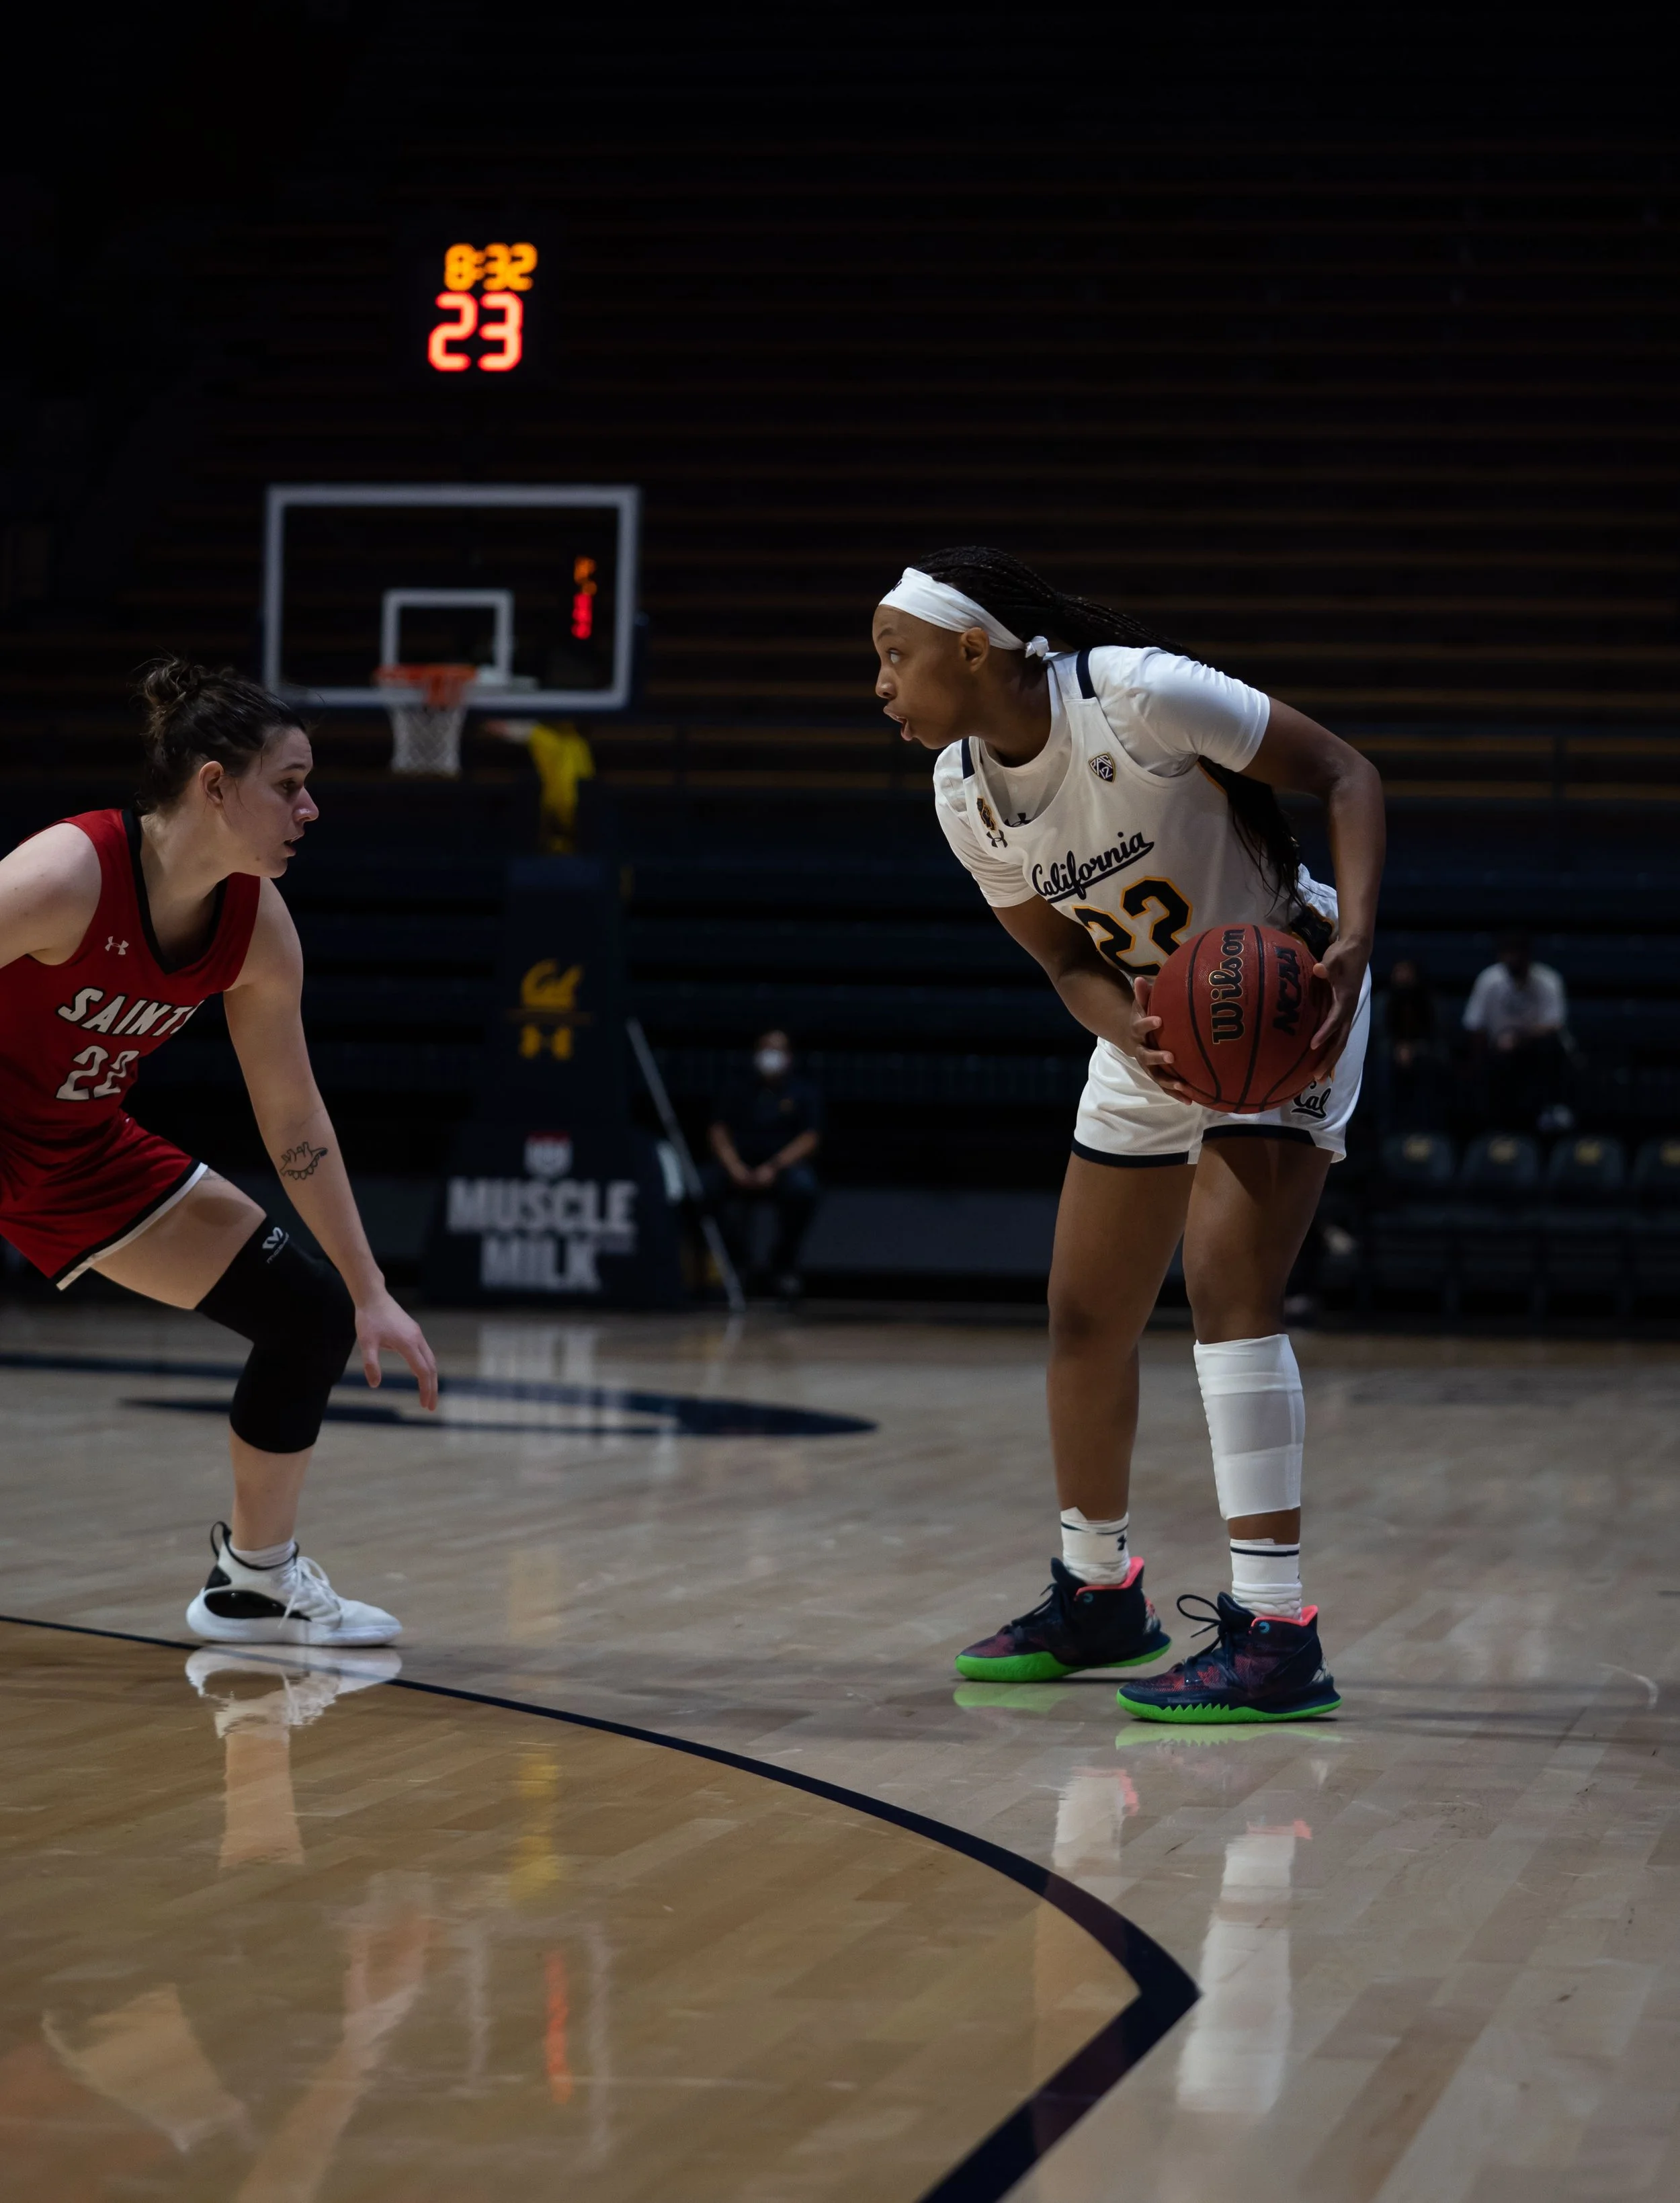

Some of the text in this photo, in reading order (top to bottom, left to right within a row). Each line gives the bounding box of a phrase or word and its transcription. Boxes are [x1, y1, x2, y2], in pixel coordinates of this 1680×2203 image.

[444, 242, 539, 292] 8:32
[427, 291, 524, 372] 23
[1089, 754, 1113, 776] PAC
[1032, 831, 1155, 904] California
[1073, 876, 1193, 976] 22
[1208, 927, 1247, 1044] Wilson
[1273, 946, 1302, 1036] NCAA
[55, 1044, 140, 1101] 22
[446, 1176, 640, 1235] MUSCLE
[480, 1235, 603, 1293] MILK
